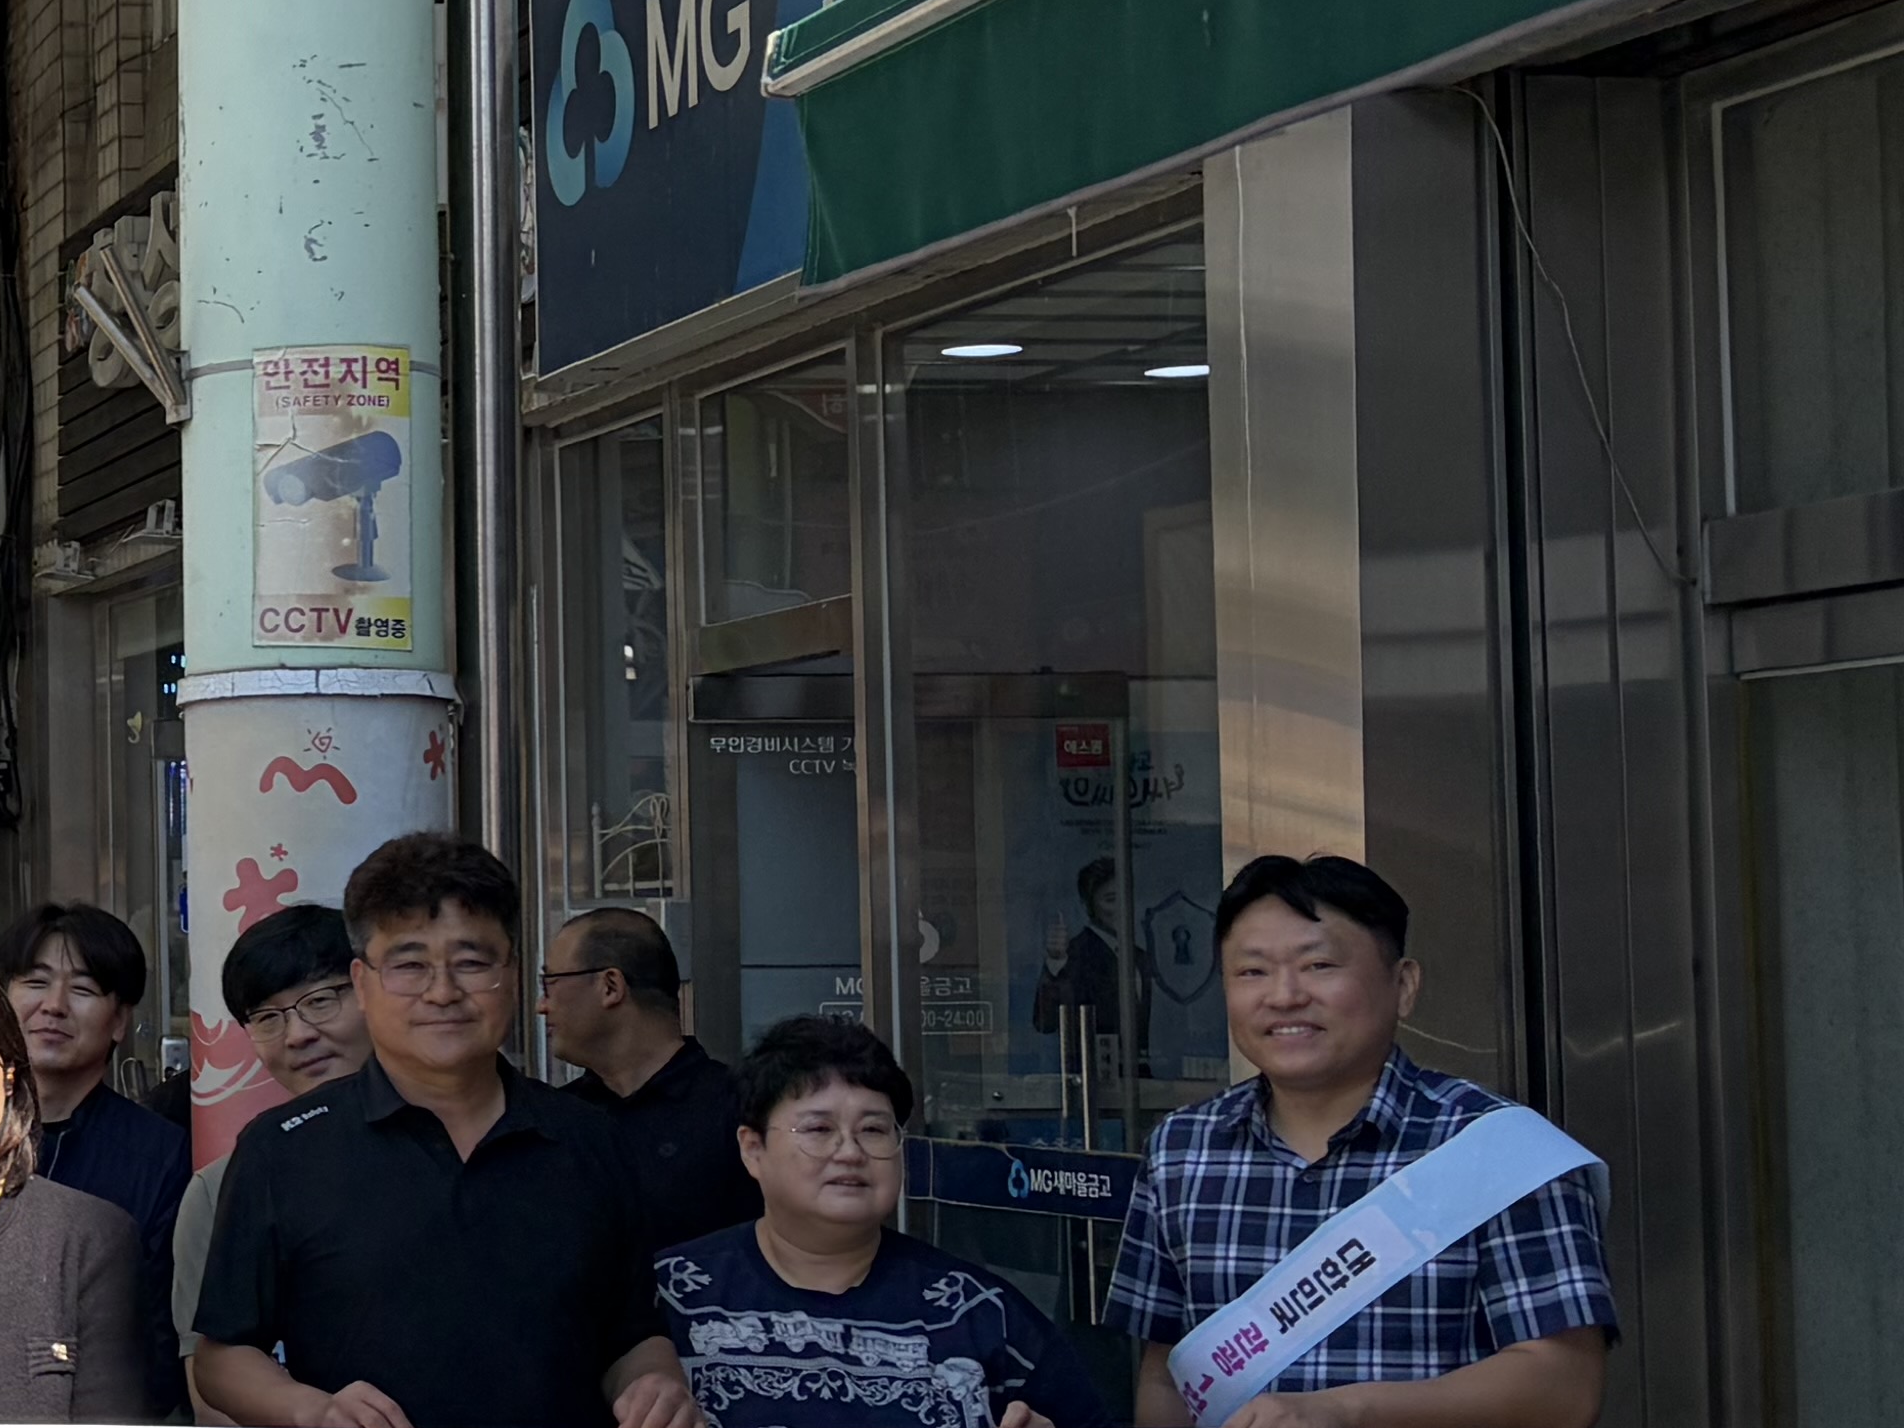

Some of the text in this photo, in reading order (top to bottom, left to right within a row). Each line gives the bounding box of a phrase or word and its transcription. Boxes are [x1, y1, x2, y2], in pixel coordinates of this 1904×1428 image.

[262, 353, 401, 392] 안전지역
[346, 393, 391, 410] ZONE)
[259, 606, 407, 641] CCTV 촬영중
[709, 737, 835, 755] 무인경비시스템
[789, 759, 836, 776] CCTV
[1030, 1166, 1112, 1200] MG새마을금고
[1270, 1238, 1377, 1335] 대한민국
[1211, 1321, 1270, 1377] 관광
